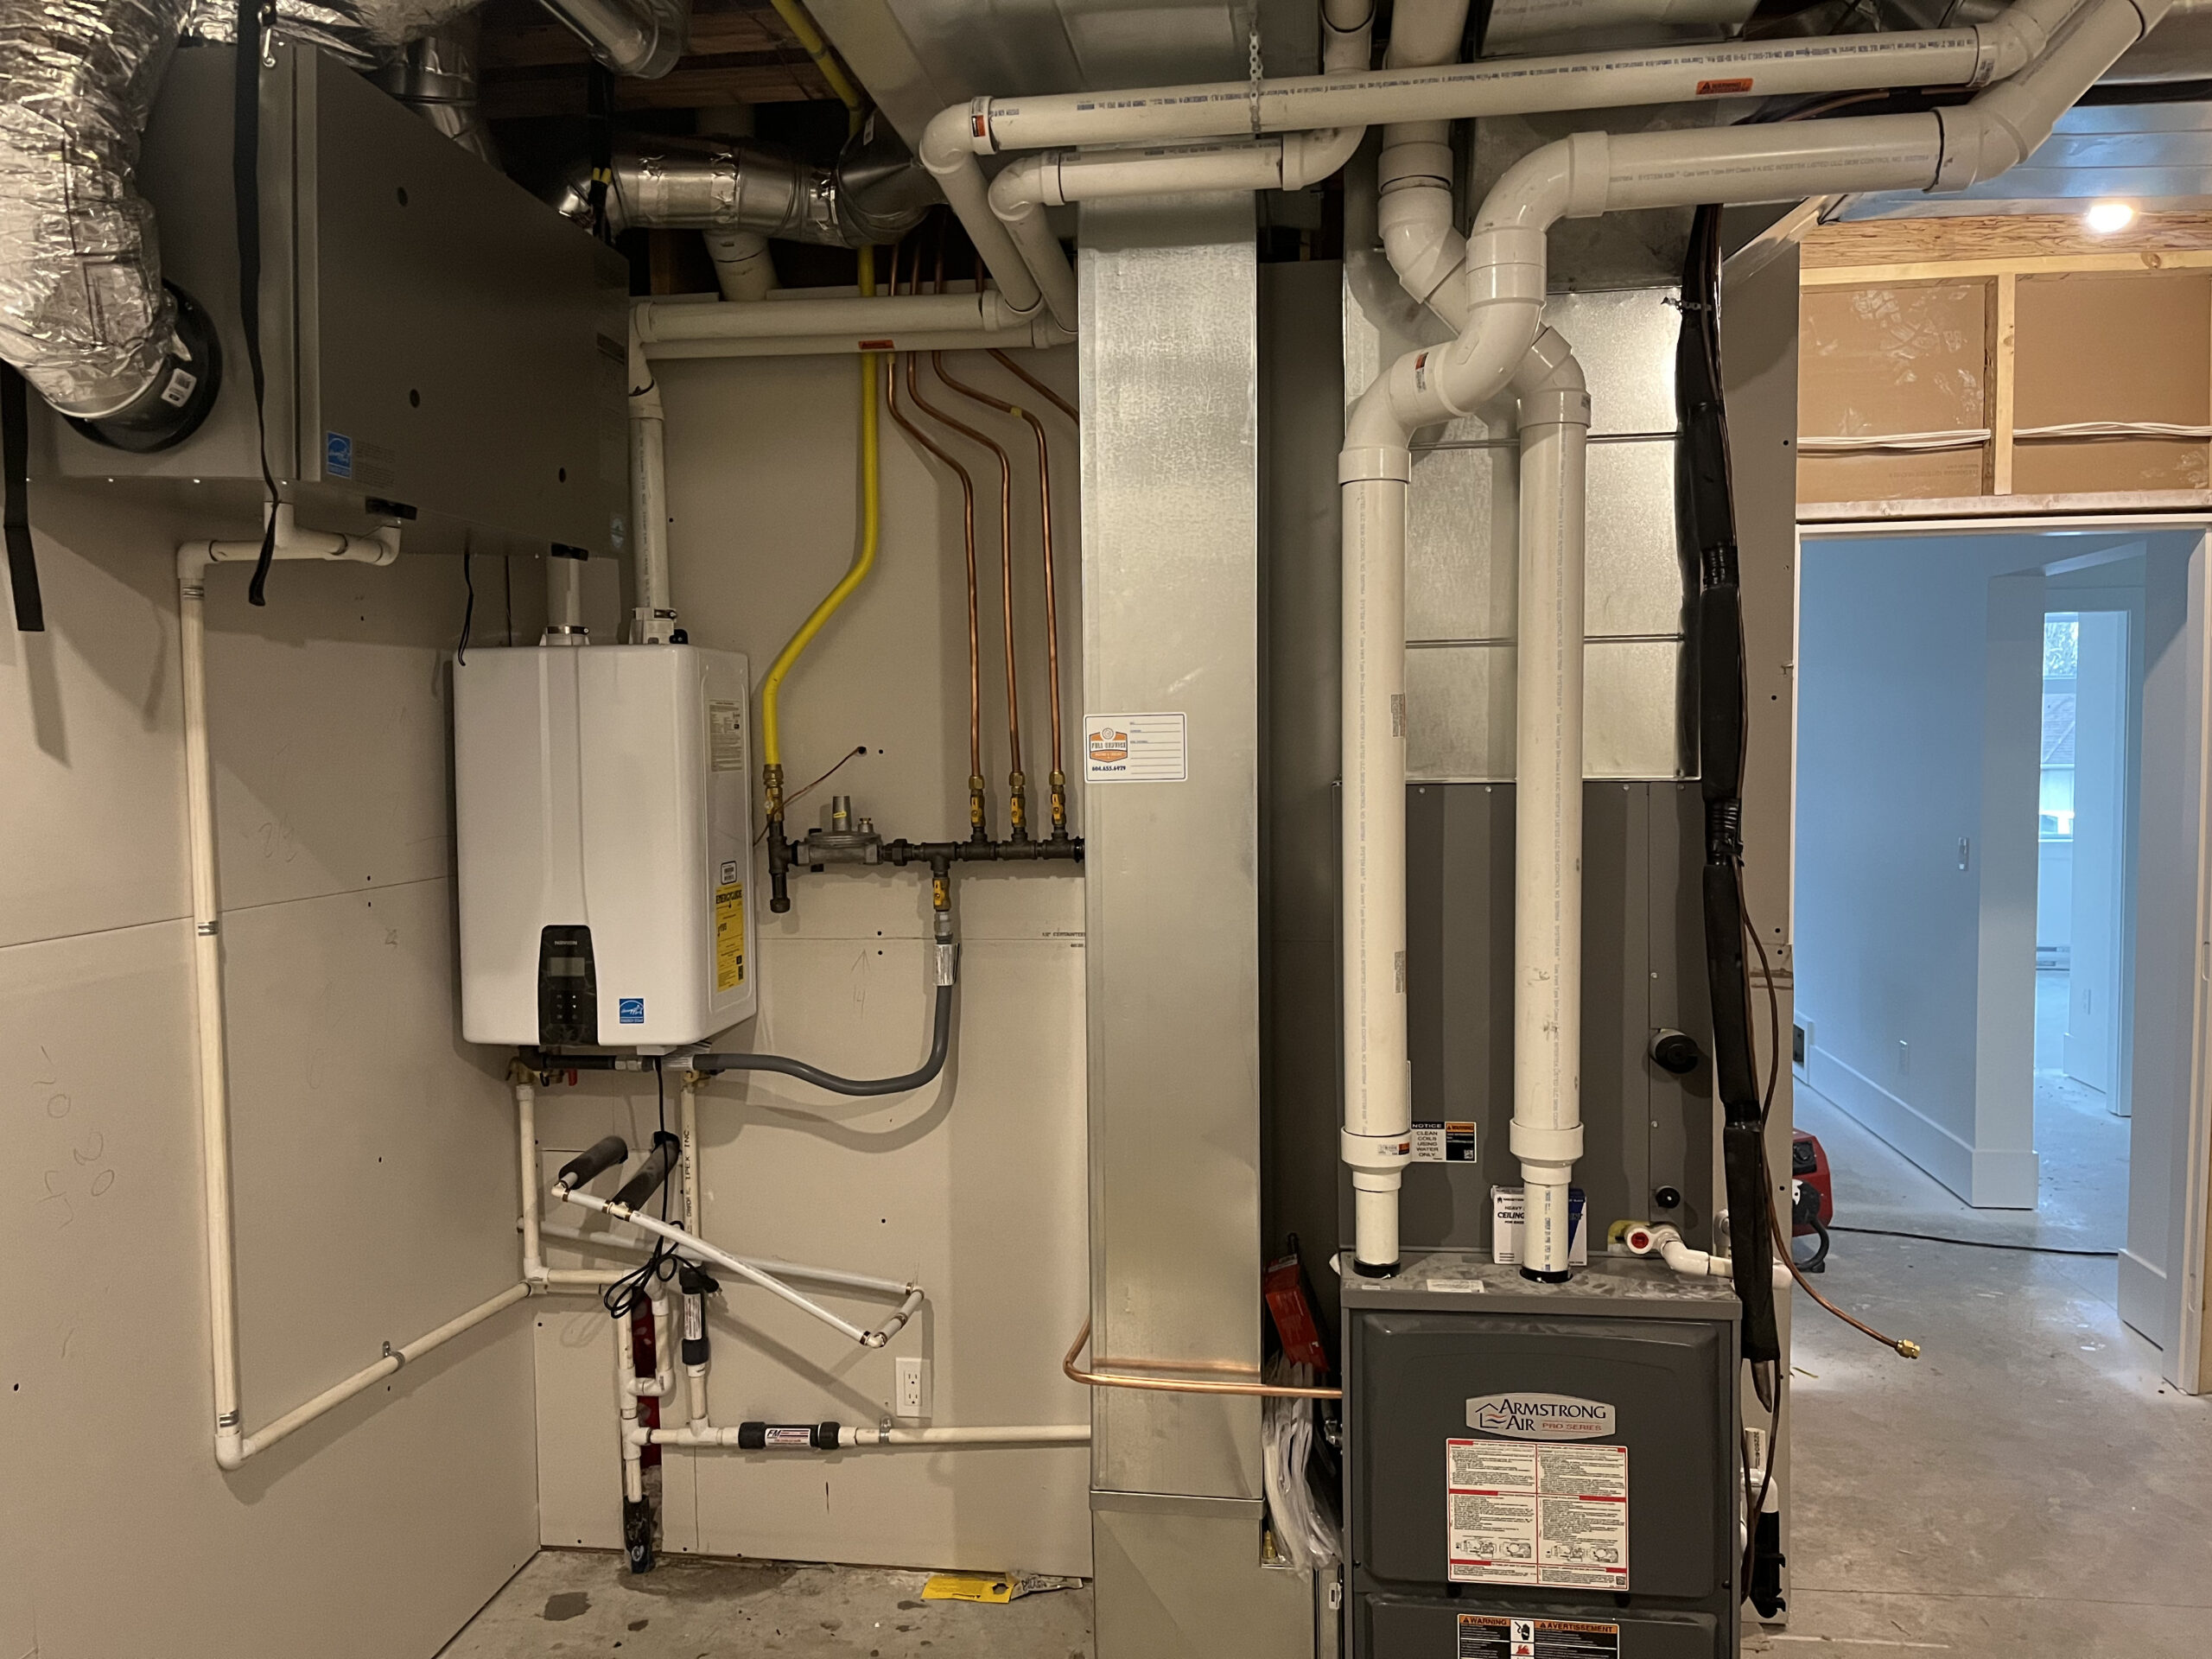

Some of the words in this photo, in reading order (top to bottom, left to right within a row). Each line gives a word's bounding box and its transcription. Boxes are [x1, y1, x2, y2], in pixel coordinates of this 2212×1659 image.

[1498, 1399, 1606, 1419] ARMSTRONG
[1505, 1415, 1535, 1431] AIR
[1567, 1423, 1602, 1432] SERIES
[1547, 1623, 1612, 1633] AVERTISSEMENT
